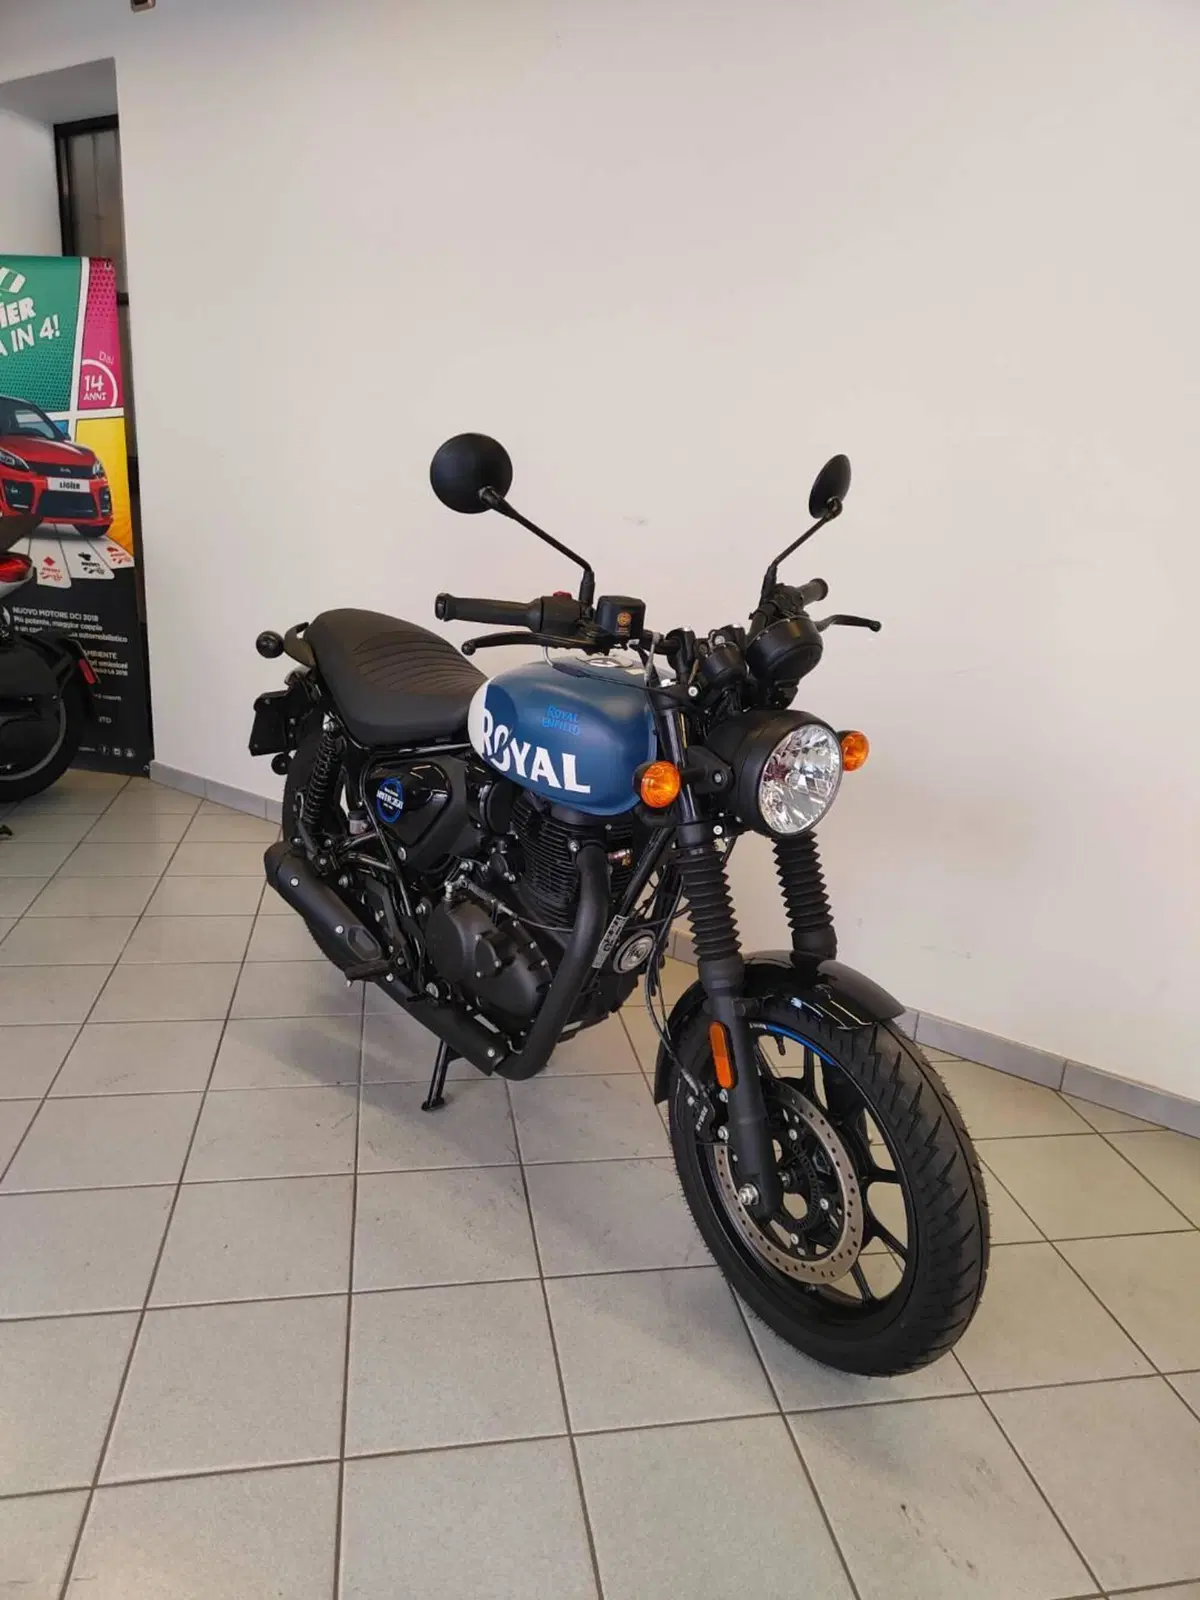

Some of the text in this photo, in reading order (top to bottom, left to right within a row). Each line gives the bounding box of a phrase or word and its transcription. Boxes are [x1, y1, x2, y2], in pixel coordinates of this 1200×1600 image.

[11, 323, 35, 352] IN
[40, 313, 60, 340] 4!
[84, 374, 104, 391] 14
[83, 391, 107, 401] ANNI
[12, 606, 38, 616] NUOVO
[38, 609, 68, 620] MOTORE
[547, 704, 579, 723] ROYAL
[541, 716, 581, 736] ENFIELD
[481, 707, 591, 794] ROYAL
